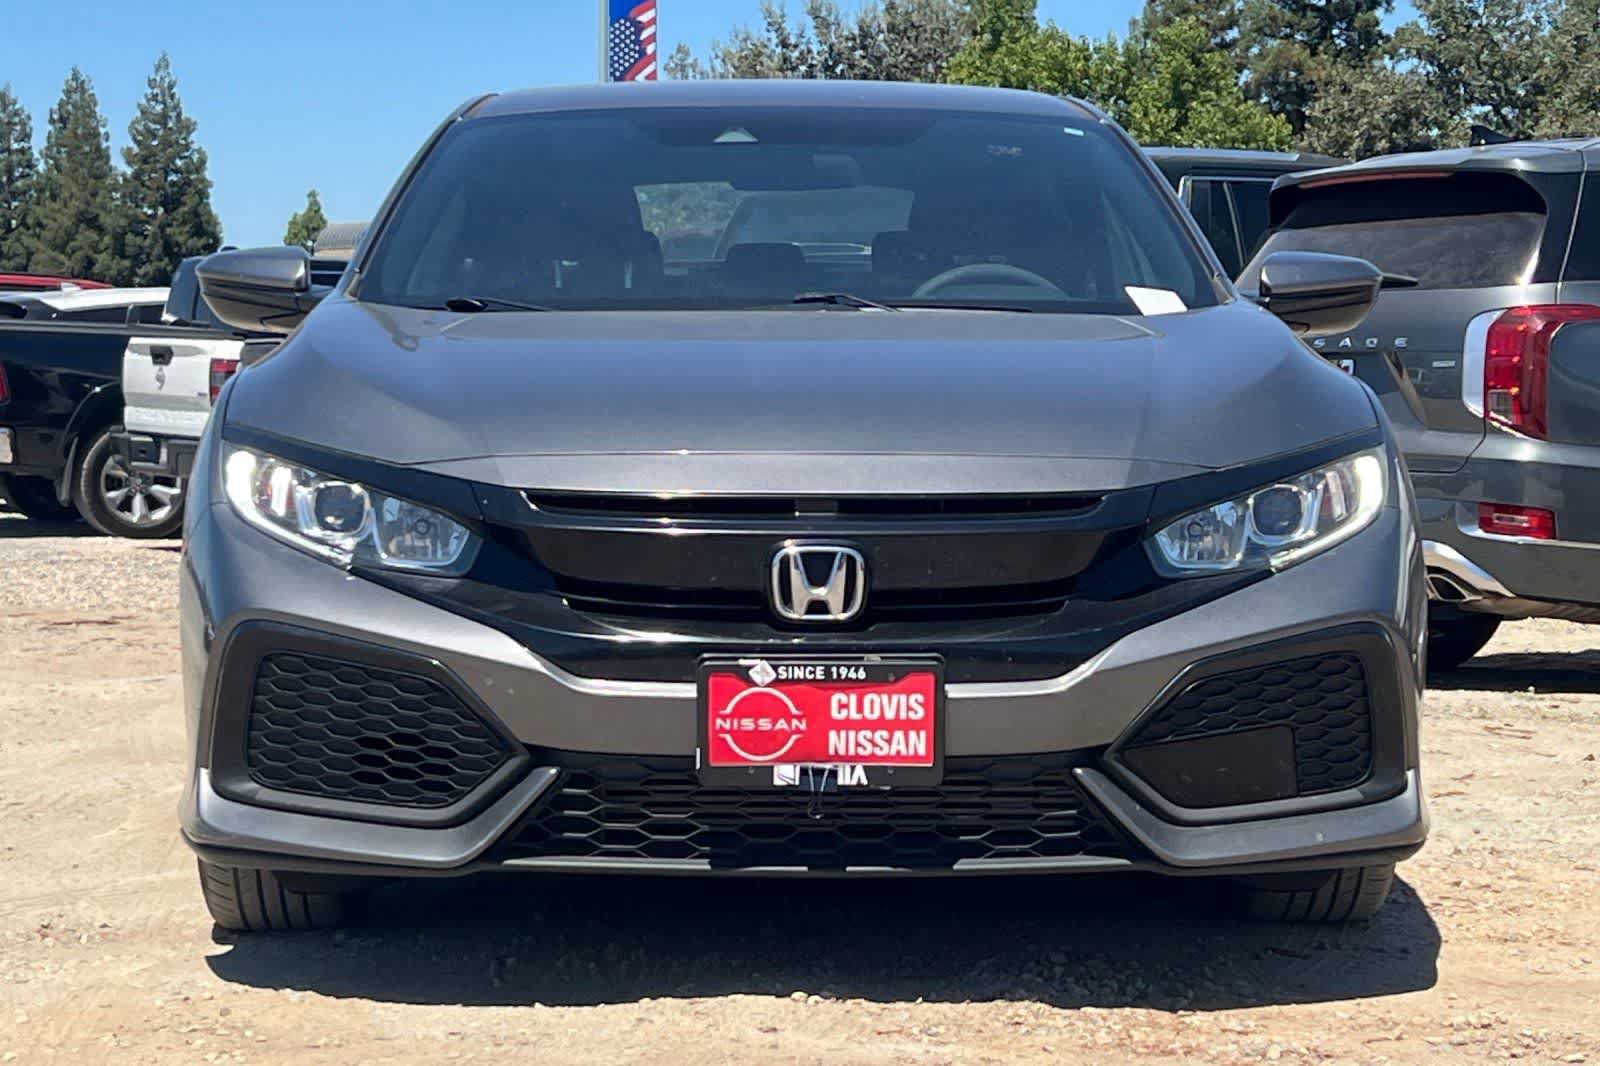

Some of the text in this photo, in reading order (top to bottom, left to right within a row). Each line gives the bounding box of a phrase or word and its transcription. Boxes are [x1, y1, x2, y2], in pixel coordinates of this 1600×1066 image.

[778, 666, 866, 680] SINCE 1946
[830, 692, 925, 721] CLOVIS
[715, 717, 807, 731] NISSAN
[828, 730, 926, 757] NISSAN
